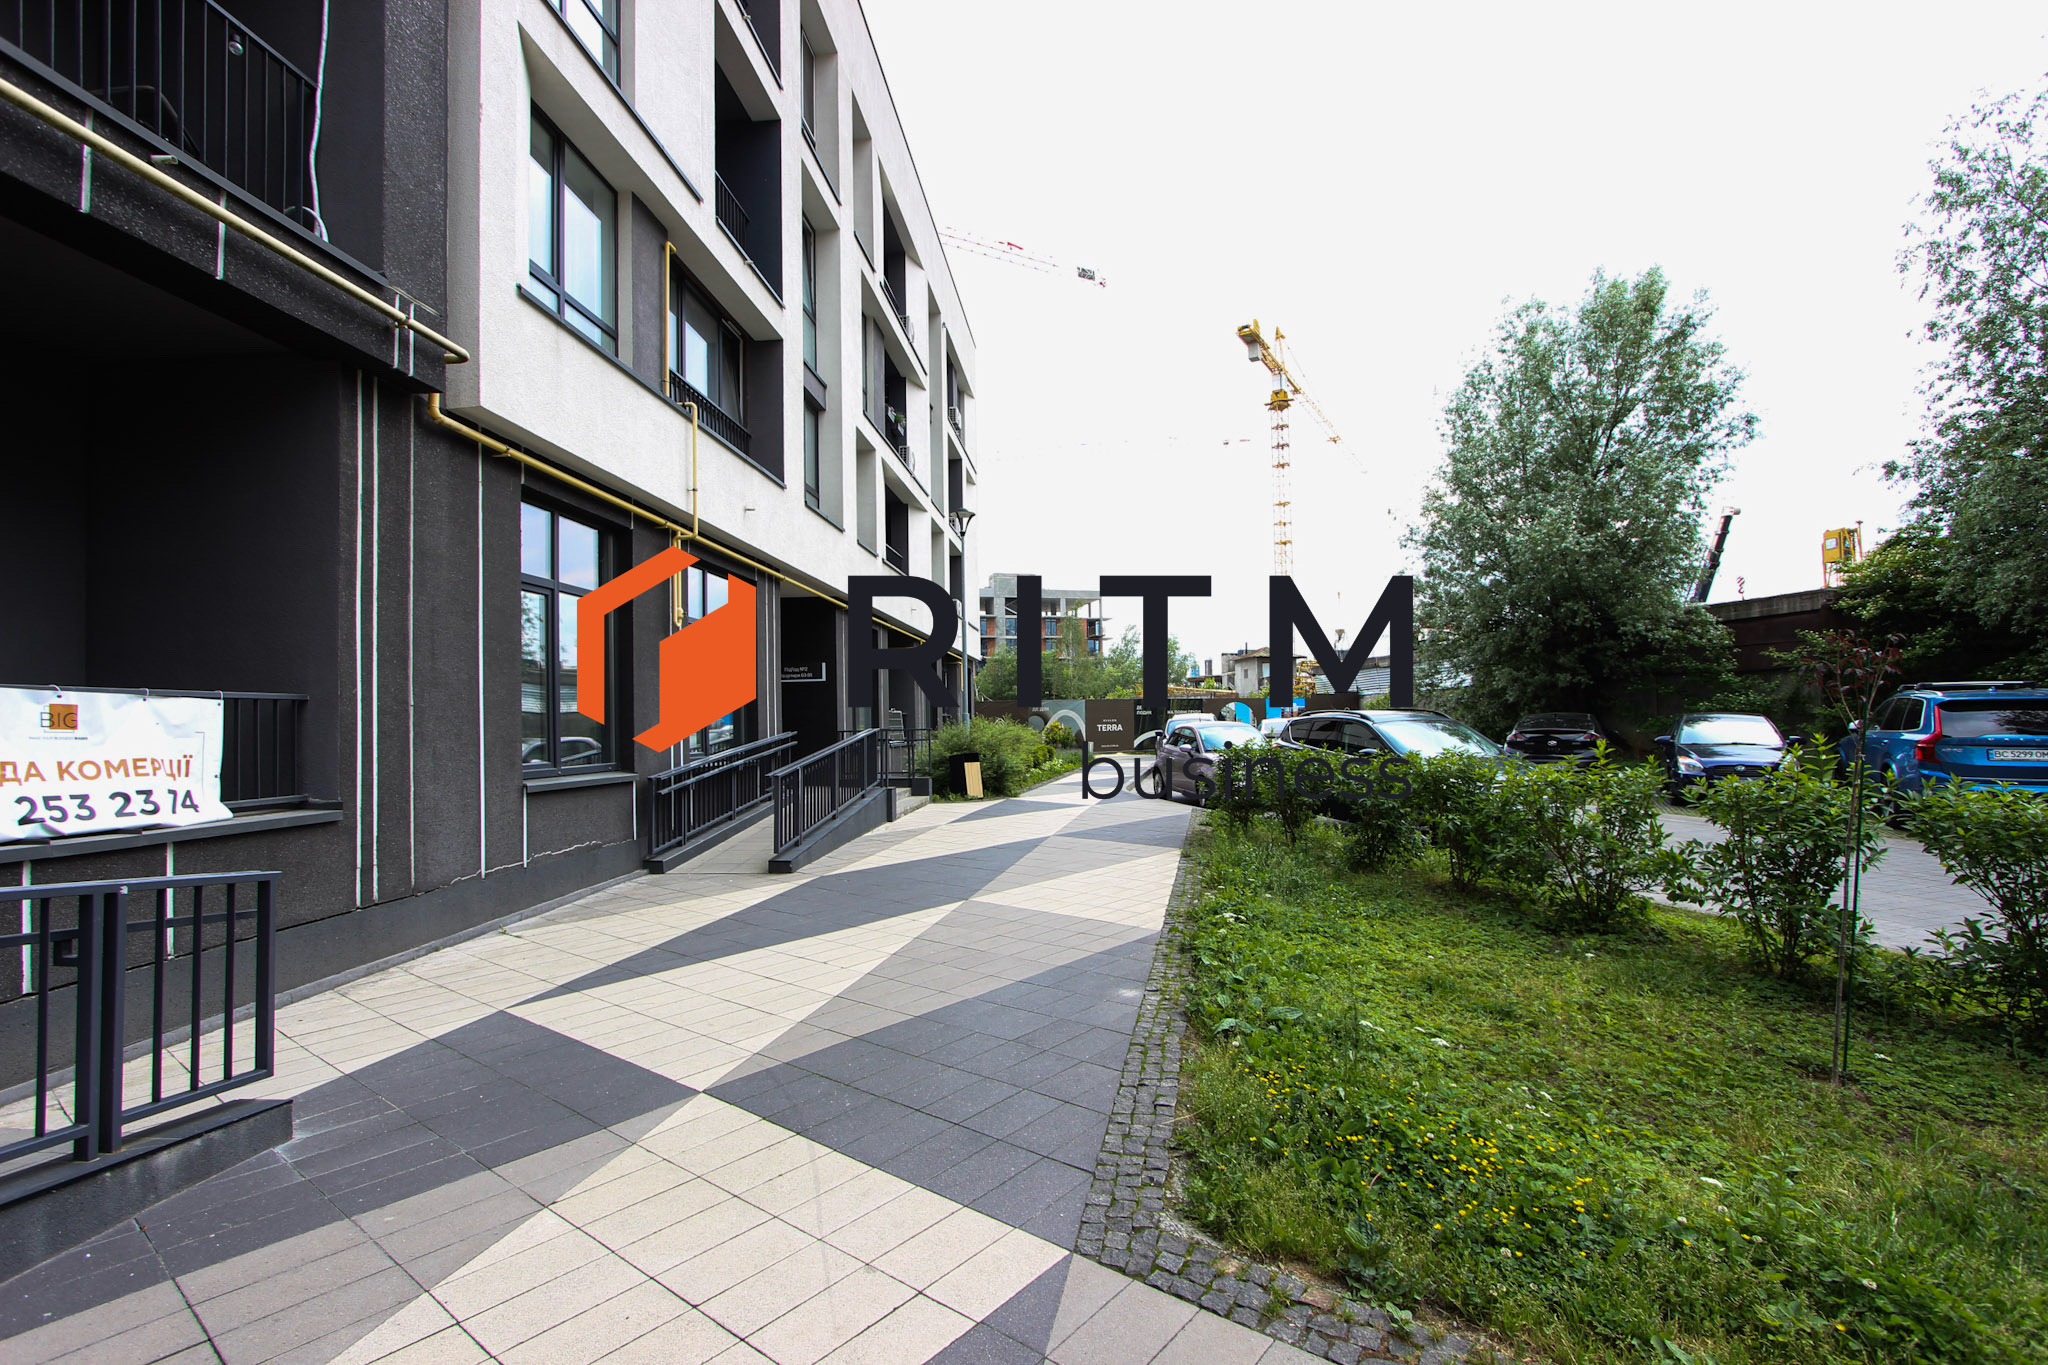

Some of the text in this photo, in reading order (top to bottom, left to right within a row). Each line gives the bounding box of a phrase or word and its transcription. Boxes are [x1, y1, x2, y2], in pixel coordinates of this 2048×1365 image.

[40, 712, 77, 728] BIG
[57, 755, 192, 781] КОМЕРЦІЇ
[14, 794, 96, 826] 253
[109, 789, 160, 818] 23
